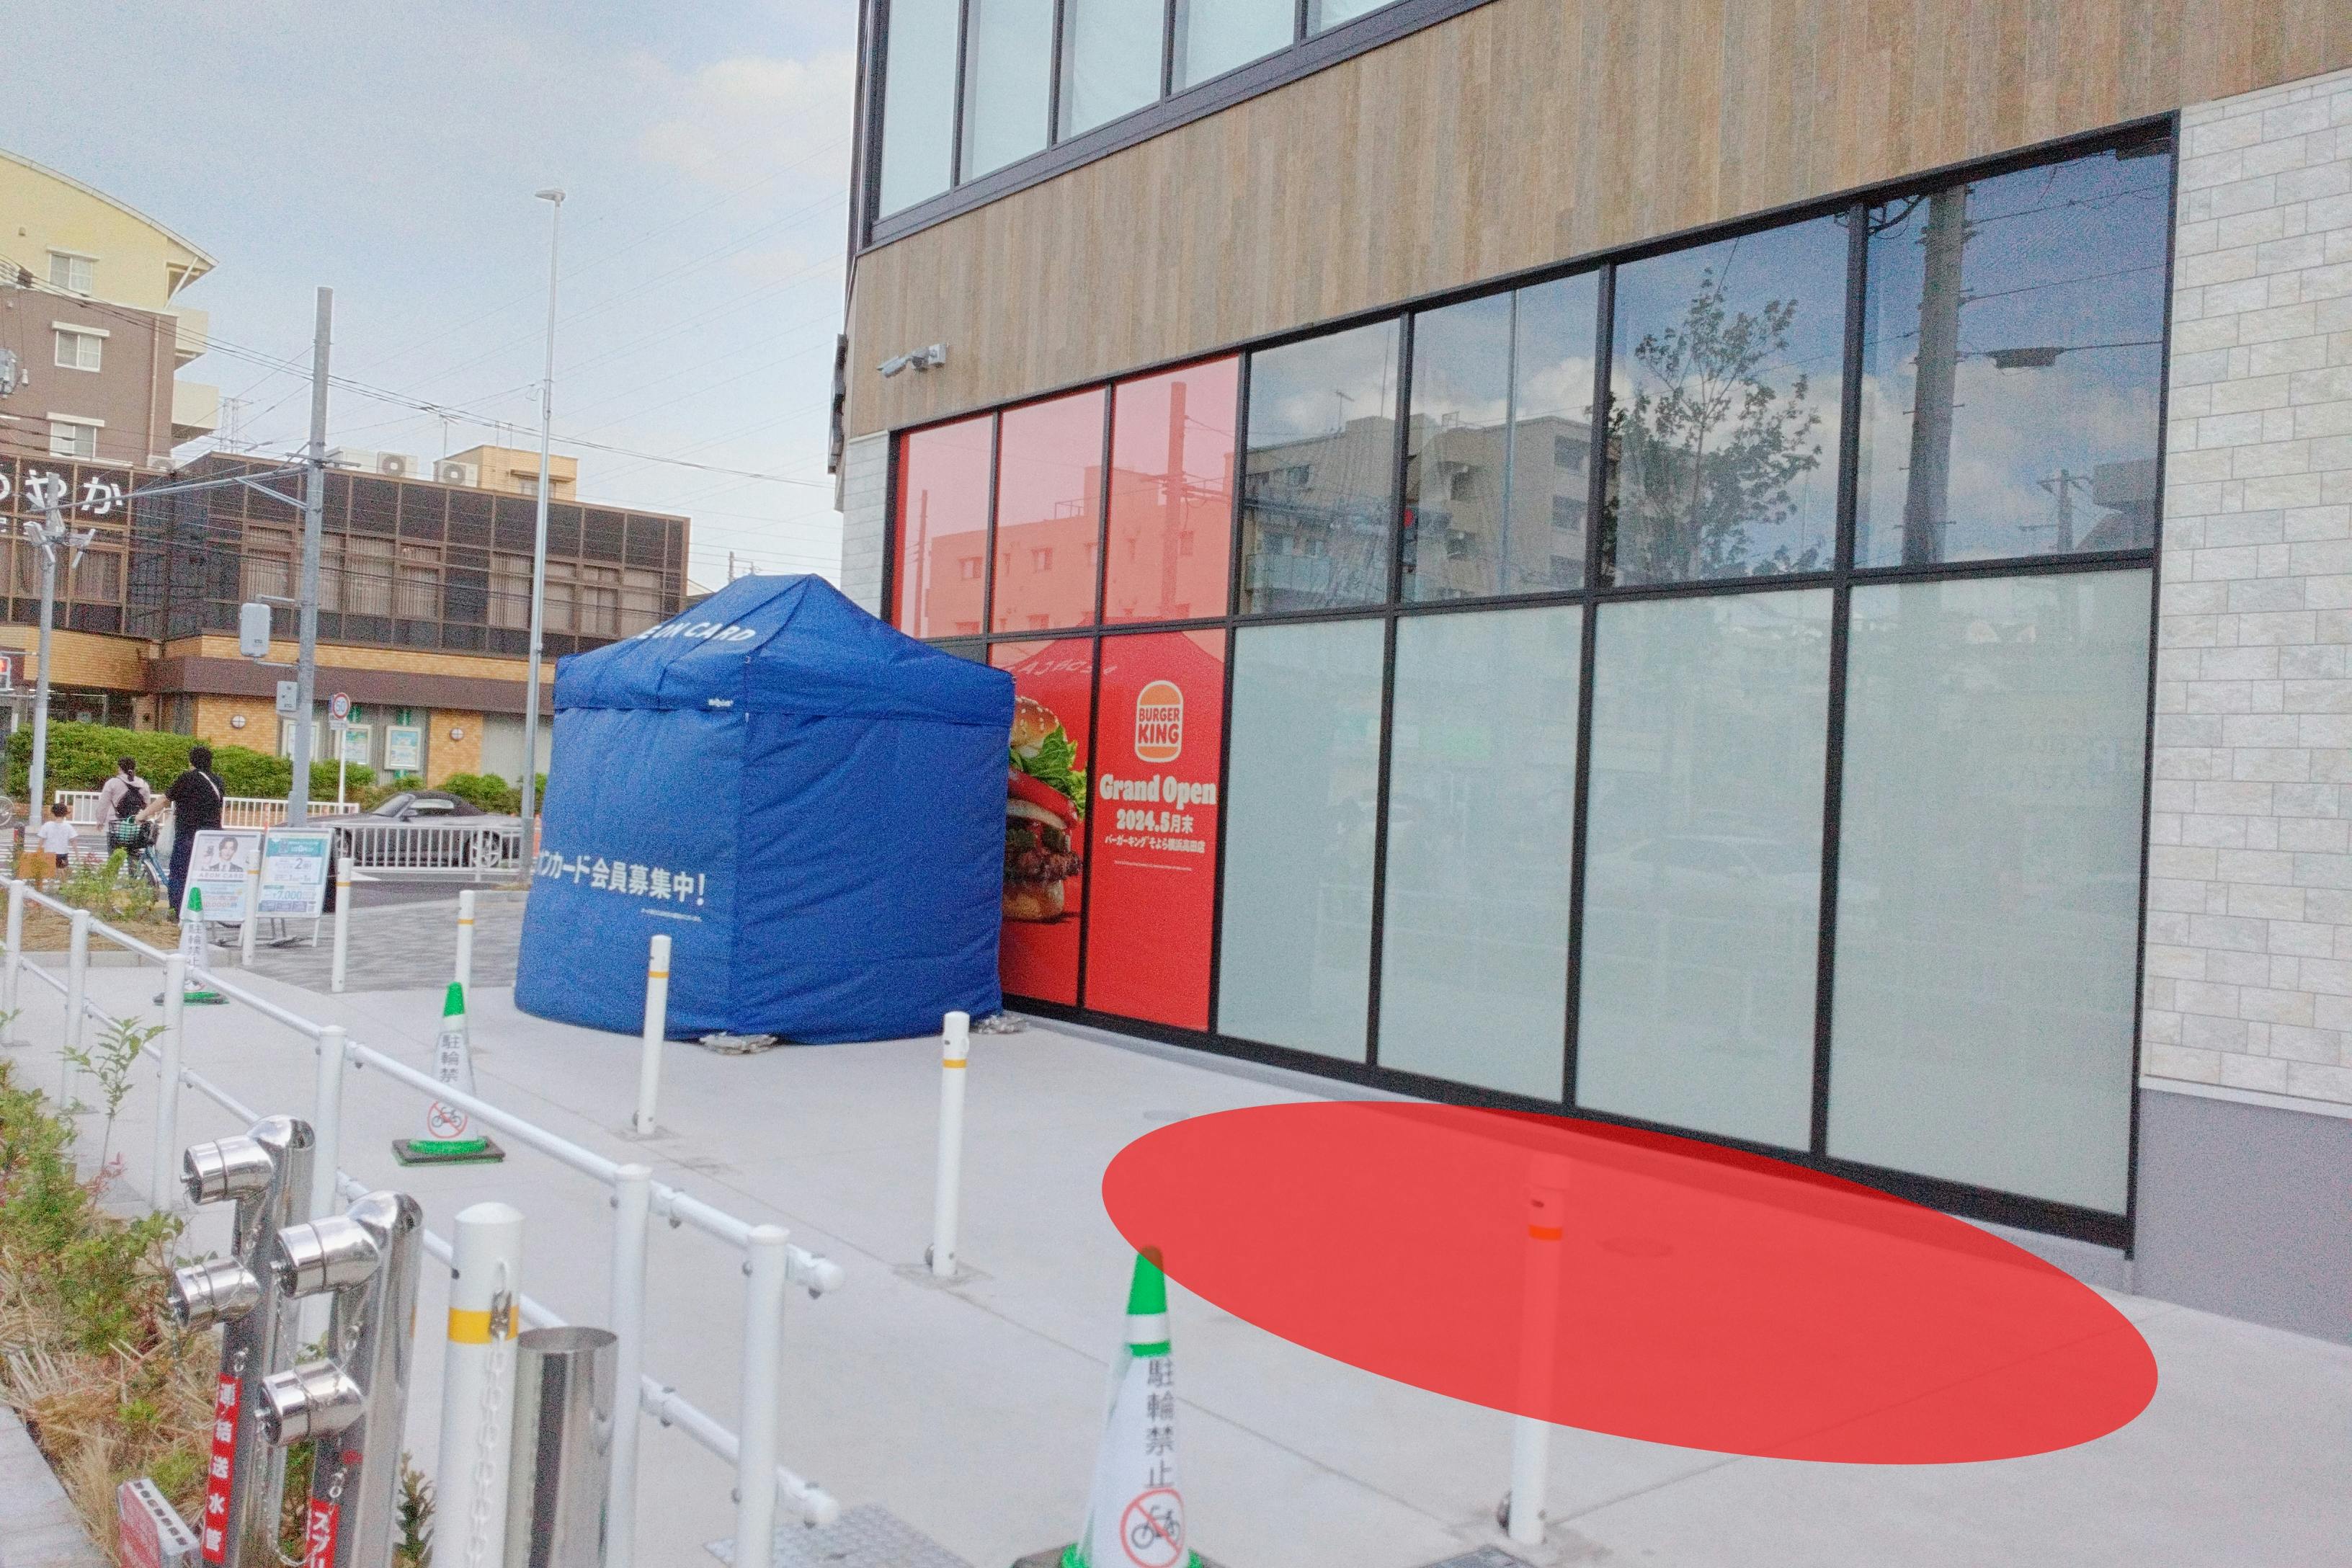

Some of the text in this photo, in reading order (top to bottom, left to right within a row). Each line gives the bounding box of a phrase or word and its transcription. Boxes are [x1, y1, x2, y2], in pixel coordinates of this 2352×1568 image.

[684, 622, 756, 641] CARD
[1138, 707, 1180, 722] BURGER
[1137, 723, 1179, 744] KING
[1099, 773, 1216, 811] Grand Open
[1116, 808, 1194, 834] 2024.5月末
[538, 848, 705, 906] ンカード会員募集中!
[440, 1034, 460, 1082] 駐輪禁
[1144, 1358, 1175, 1488] 駐輪禁止
